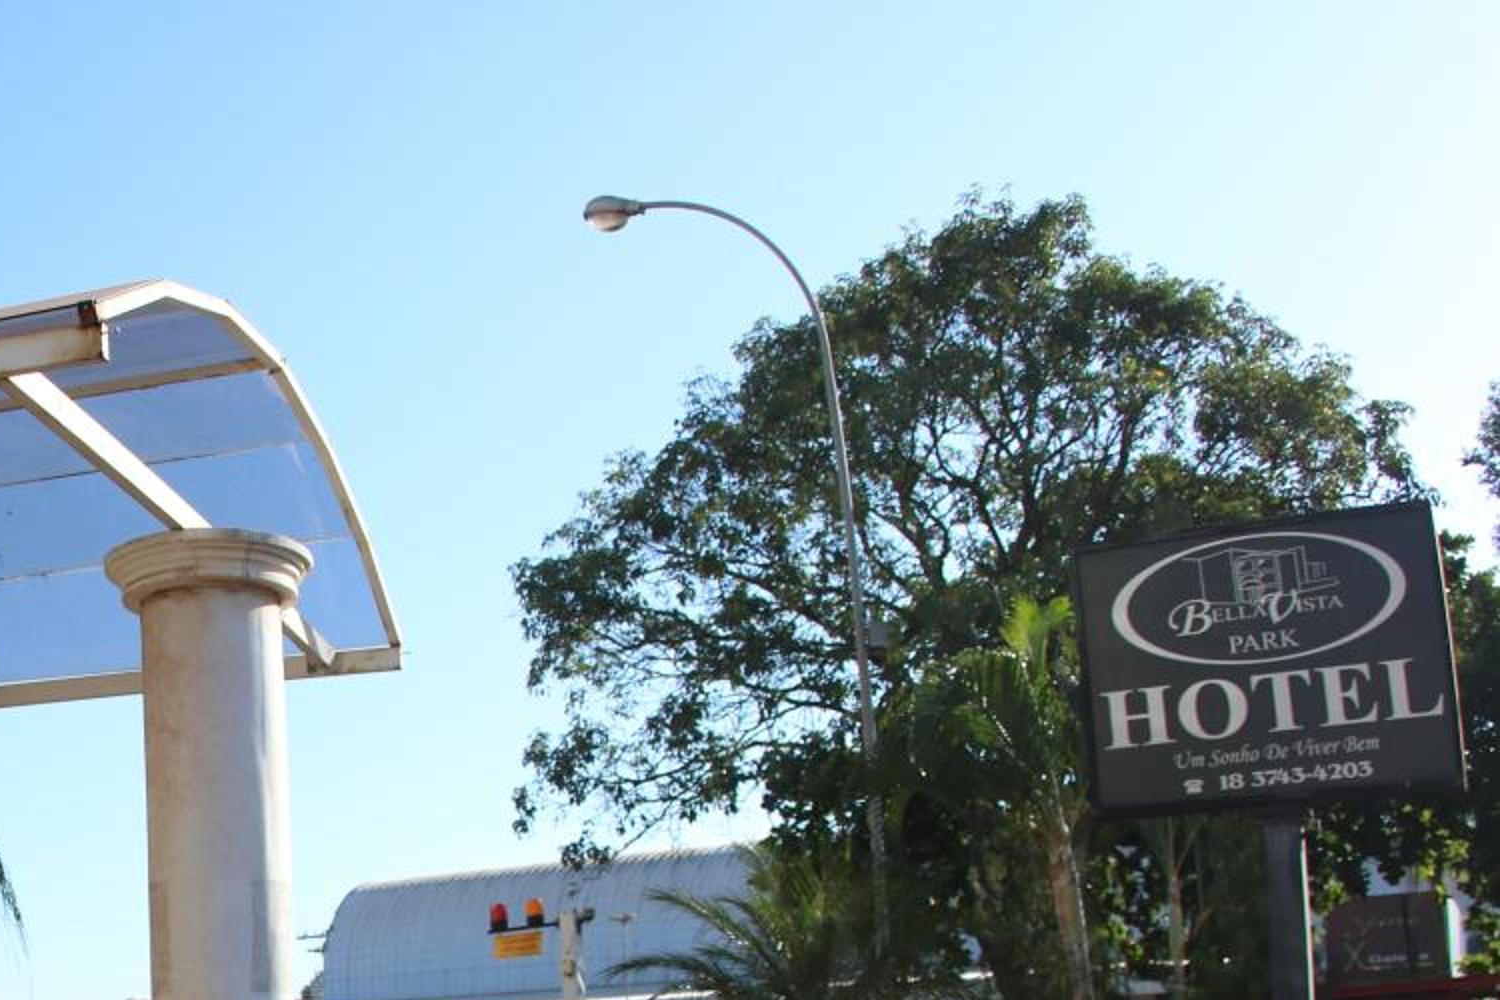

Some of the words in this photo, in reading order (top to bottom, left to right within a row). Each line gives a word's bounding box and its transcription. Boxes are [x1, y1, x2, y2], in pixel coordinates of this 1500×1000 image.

[1167, 599, 1268, 637] BELLA
[1259, 589, 1344, 625] VISTA
[1228, 628, 1299, 654] PARK
[1100, 657, 1445, 751] HOTEL
[1174, 750, 1205, 769] Um
[1208, 743, 1261, 768] Sonho
[1266, 743, 1290, 760] De
[1296, 738, 1341, 756] Viver
[1344, 735, 1381, 753] Bem
[1219, 773, 1245, 791] 18
[1251, 760, 1375, 788] 3743-4203
